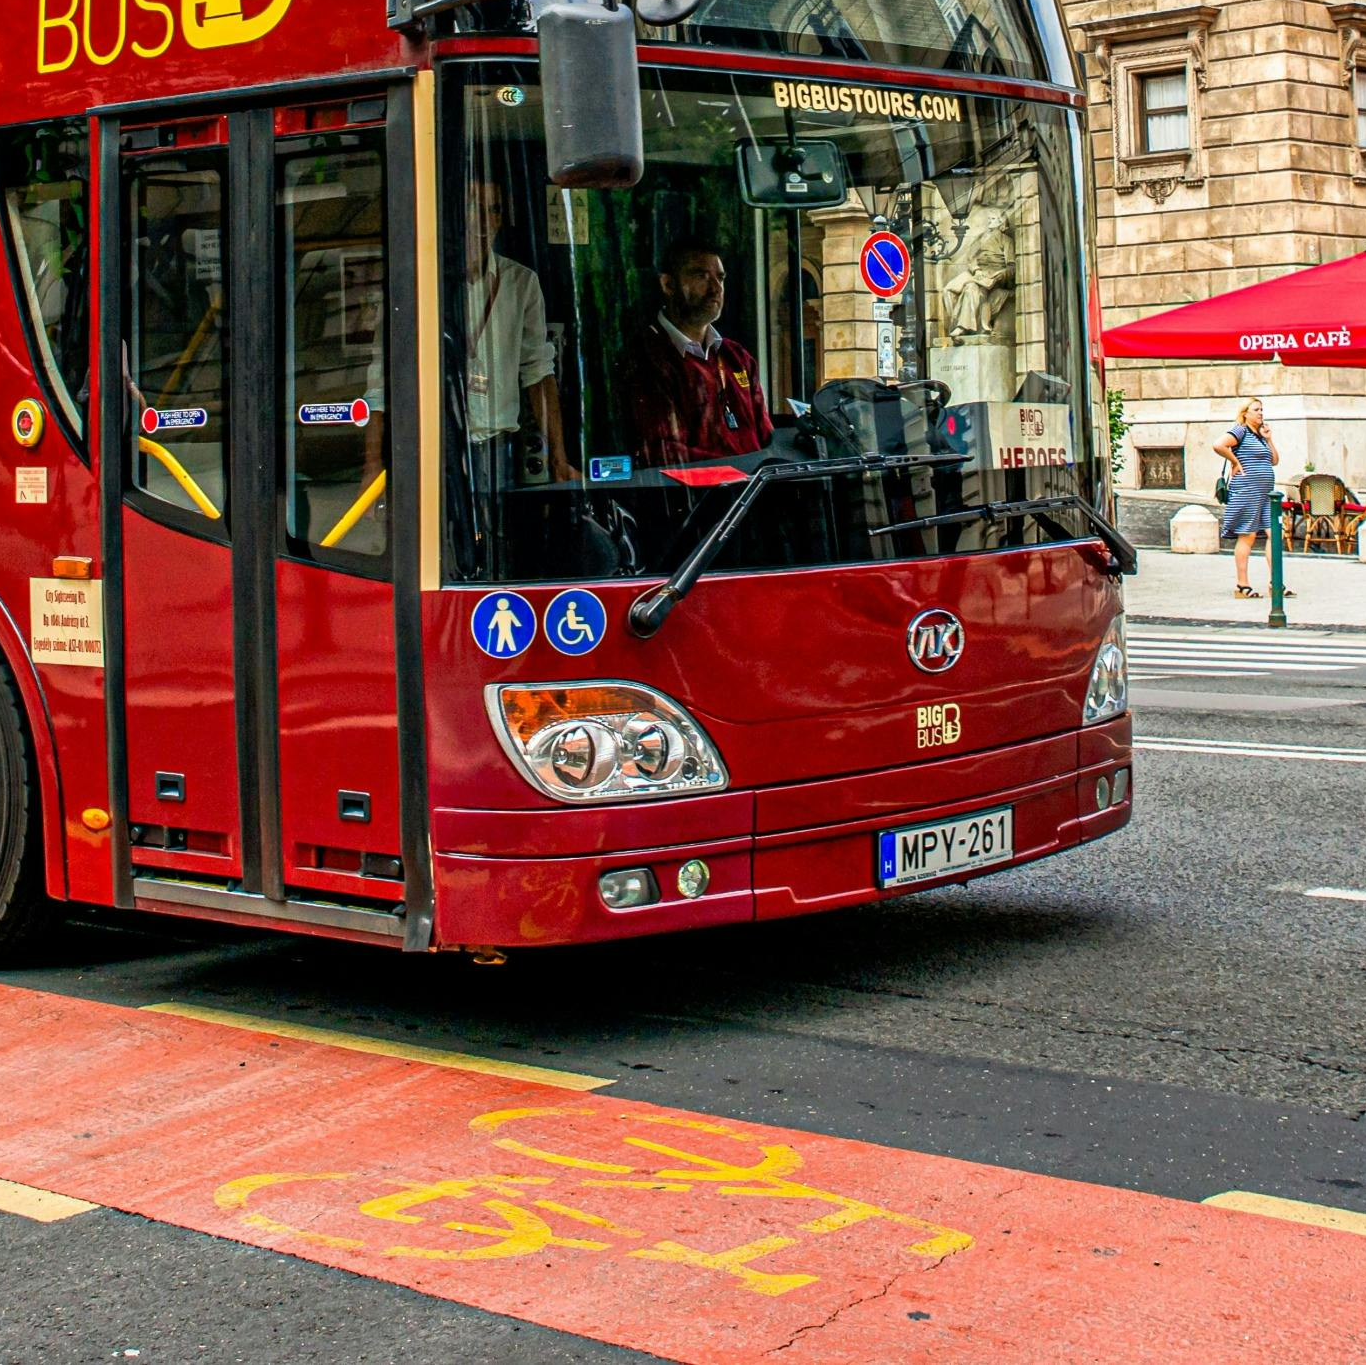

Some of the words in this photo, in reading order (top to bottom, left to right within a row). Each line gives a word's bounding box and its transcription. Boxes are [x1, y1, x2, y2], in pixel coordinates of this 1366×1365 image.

[773, 81, 961, 122] BIGBUSTOURS.COM
[1239, 334, 1299, 350] OPERA
[172, 411, 182, 419] HERE
[189, 410, 201, 418] OPEN
[1019, 408, 1034, 423] BIG
[999, 447, 1067, 469] HEROES
[917, 705, 942, 728] BIG
[917, 727, 942, 749] BUS
[902, 815, 1006, 871] MPY-261
[884, 860, 892, 873] H
